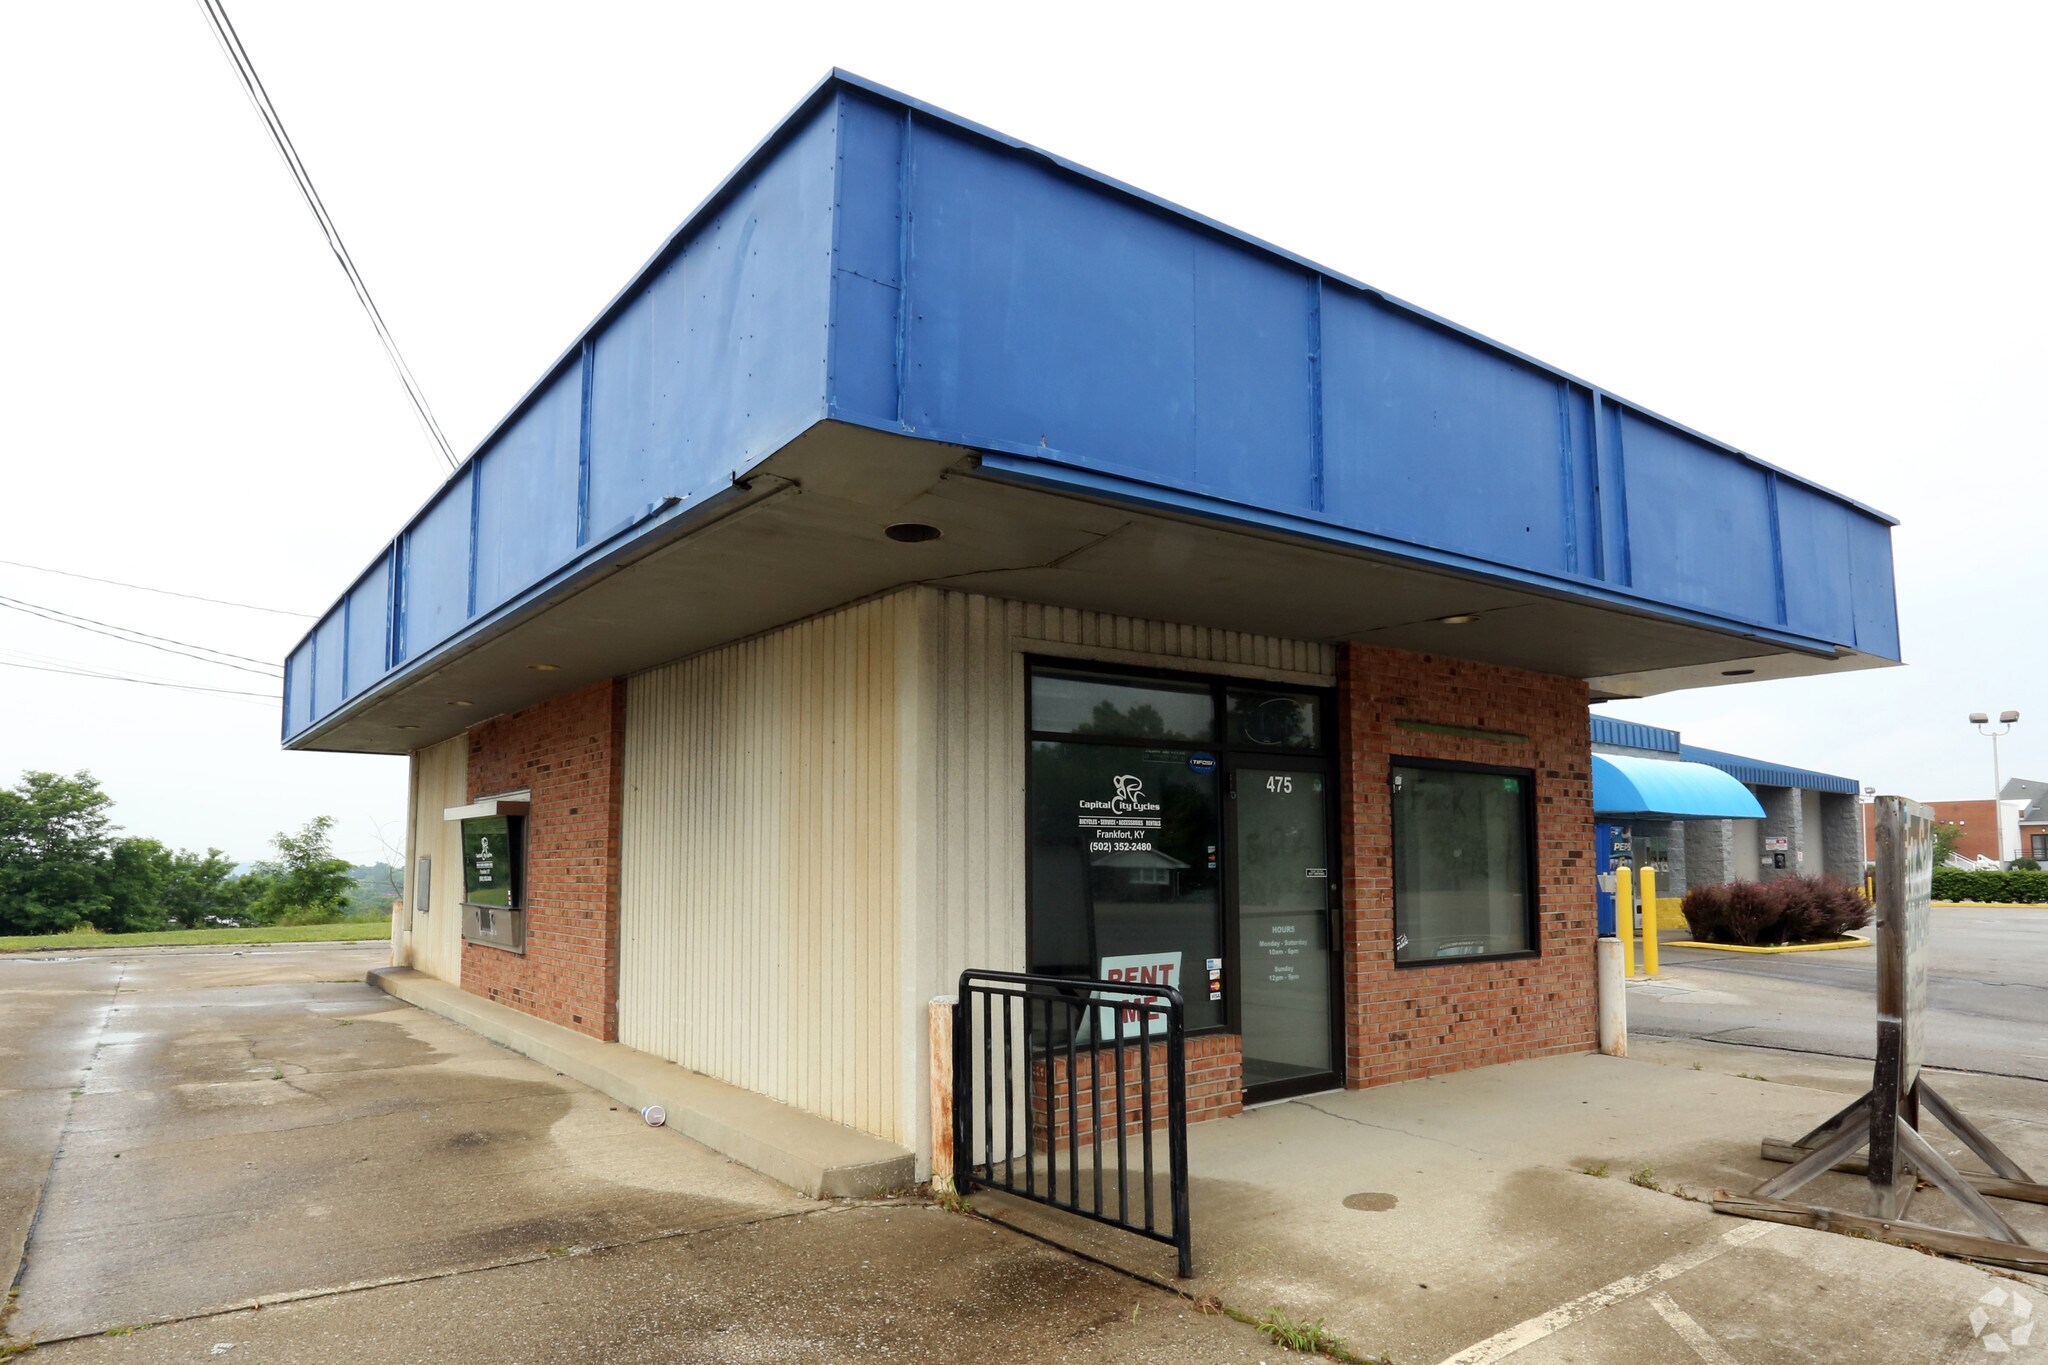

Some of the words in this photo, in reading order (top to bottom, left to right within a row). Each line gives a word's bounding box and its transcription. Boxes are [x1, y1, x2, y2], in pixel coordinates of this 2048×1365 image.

[1266, 776, 1292, 793] 475
[1079, 800, 1111, 810] Capital
[1111, 795, 1132, 815] City
[1133, 801, 1161, 811] Cycles
[1100, 818, 1116, 826] SERVICE
[1096, 830, 1133, 840] Frankfort,
[1134, 830, 1145, 839] KY
[1090, 842, 1112, 853] (502)
[1114, 842, 1152, 851] 352-2480
[1271, 926, 1296, 934] HOURS
[1284, 939, 1307, 947] Saturday
